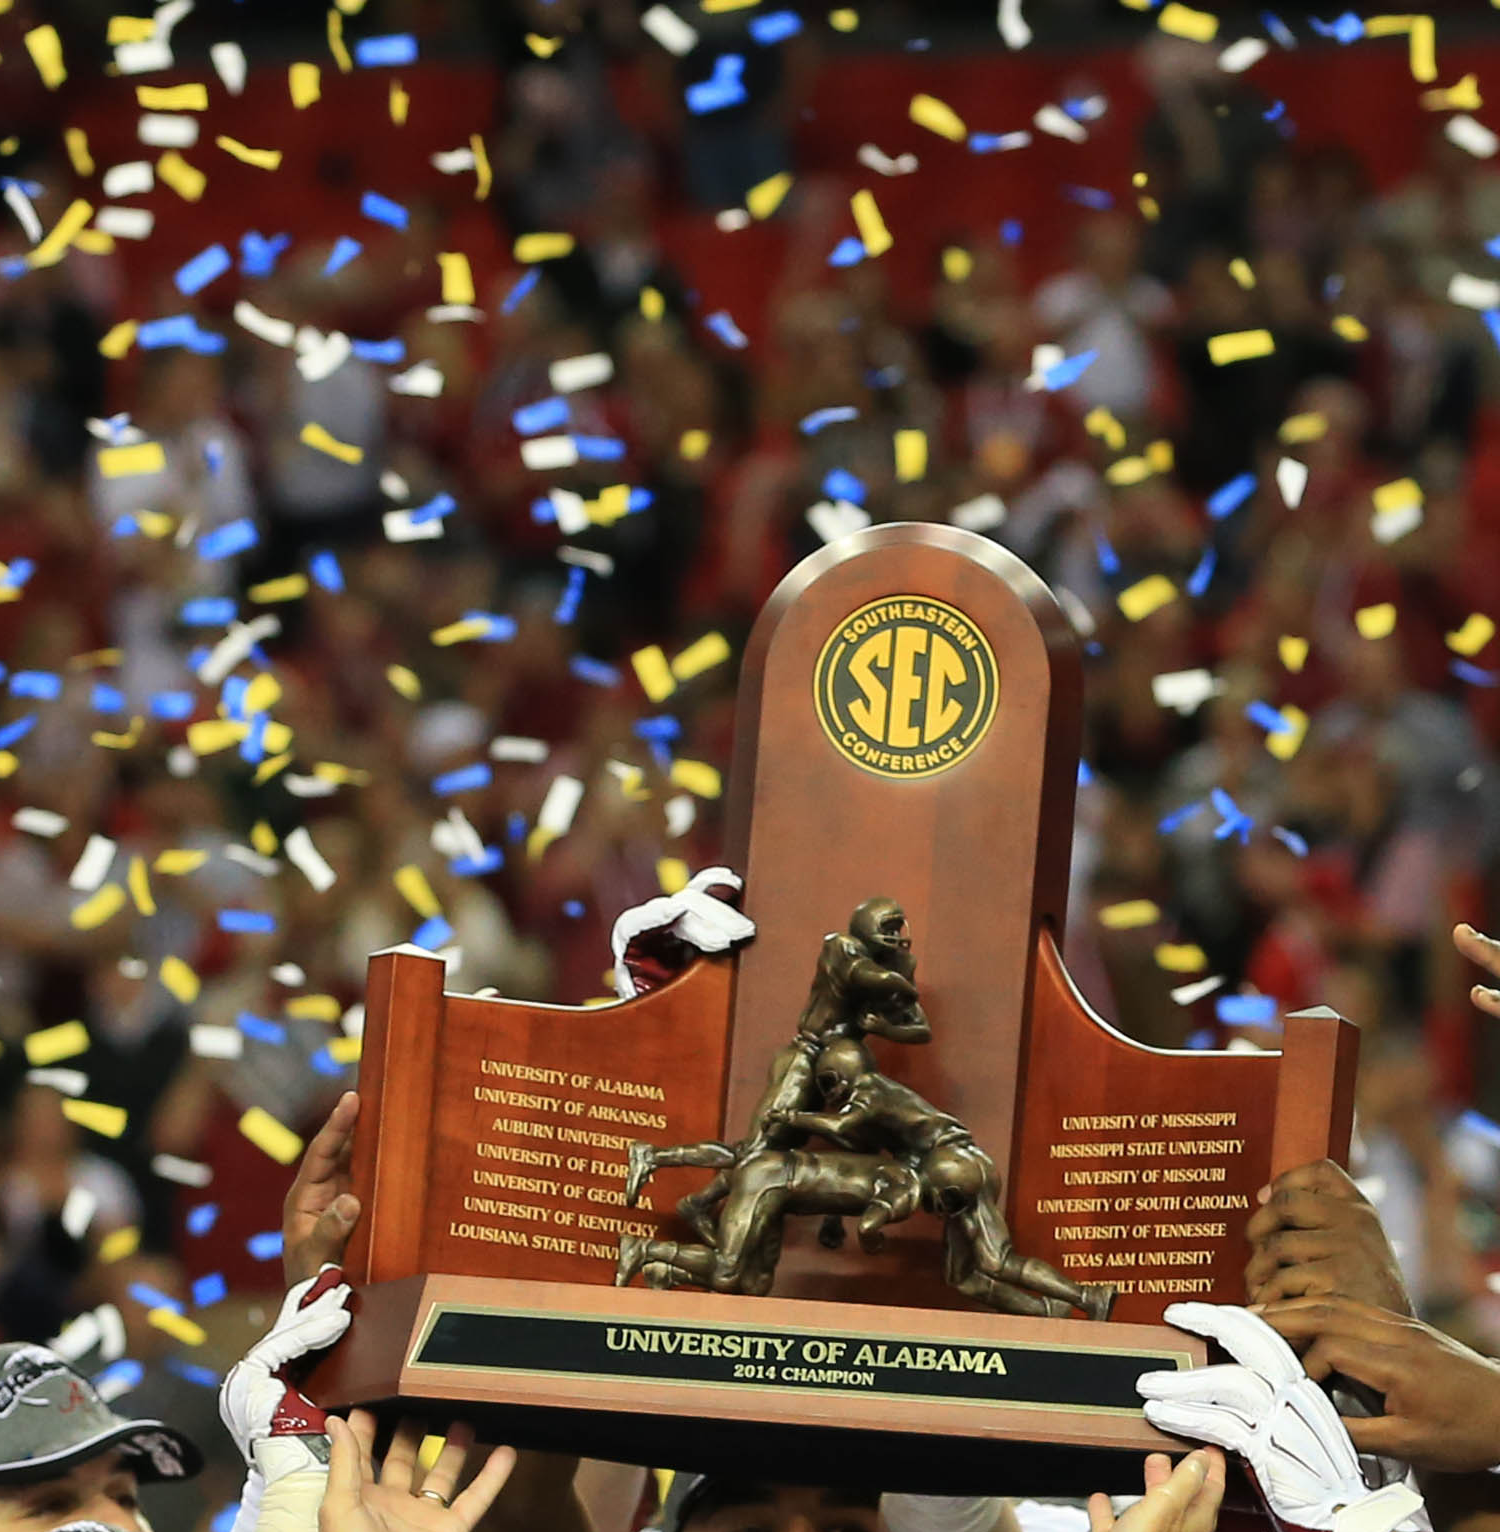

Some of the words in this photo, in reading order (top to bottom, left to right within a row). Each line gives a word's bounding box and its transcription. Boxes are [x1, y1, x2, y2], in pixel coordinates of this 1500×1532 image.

[843, 603, 978, 650] SOUTHEASTERN
[847, 626, 967, 748] SEC
[842, 732, 964, 770] CONFERENCE
[481, 1059, 568, 1085] UNIVERSITY
[571, 1074, 592, 1089] OF
[594, 1079, 665, 1101] ALABAMA
[474, 1086, 560, 1112] UNIVERSITY
[564, 1101, 585, 1116] OF
[588, 1105, 667, 1129] ARKANSAS
[1062, 1115, 1138, 1130] UNIVERSITY
[1140, 1114, 1159, 1128] OF
[1161, 1112, 1237, 1127] MISSISSIPPI
[492, 1118, 554, 1138] AUBURN
[557, 1128, 637, 1150] UNIVERSIT
[1050, 1143, 1124, 1158] MISSISSIPPI
[1126, 1142, 1165, 1156] STATE
[1169, 1140, 1244, 1155] UNIVERSITY
[476, 1143, 563, 1168] UNIVERSITY
[567, 1157, 588, 1172] OF
[473, 1170, 560, 1196] UNIVERSITY
[563, 1184, 584, 1199] OF
[587, 1188, 653, 1211] GEORIA
[1064, 1170, 1139, 1185] UNIVERSITY
[1142, 1169, 1160, 1183] OF
[1163, 1168, 1226, 1183] MISSOURI
[464, 1196, 551, 1222] UNIVERSITY
[554, 1210, 575, 1226] OF
[578, 1214, 658, 1238] KENTUCKY
[1037, 1198, 1112, 1213] UNIVERSITY
[1114, 1197, 1133, 1211] OF
[1134, 1196, 1180, 1210] SOUTH
[1183, 1195, 1248, 1210] CAROLINA
[450, 1223, 528, 1247] LOUISIANA
[531, 1235, 576, 1254] STATE
[1054, 1225, 1129, 1240] UNIVERSITY
[1132, 1224, 1150, 1238] OF
[1153, 1223, 1226, 1238] TENNESSEE
[1062, 1253, 1103, 1267] TEXAS
[1106, 1252, 1135, 1266] A&M
[1138, 1250, 1215, 1265] UNIVERSITY
[1138, 1278, 1214, 1293] UNIVERSITY
[606, 1328, 794, 1361] UNIVERSITY
[802, 1340, 847, 1364] OF
[853, 1345, 1007, 1375] ALABAMA
[733, 1364, 776, 1380] 2014
[781, 1366, 875, 1386] CHAMPION
